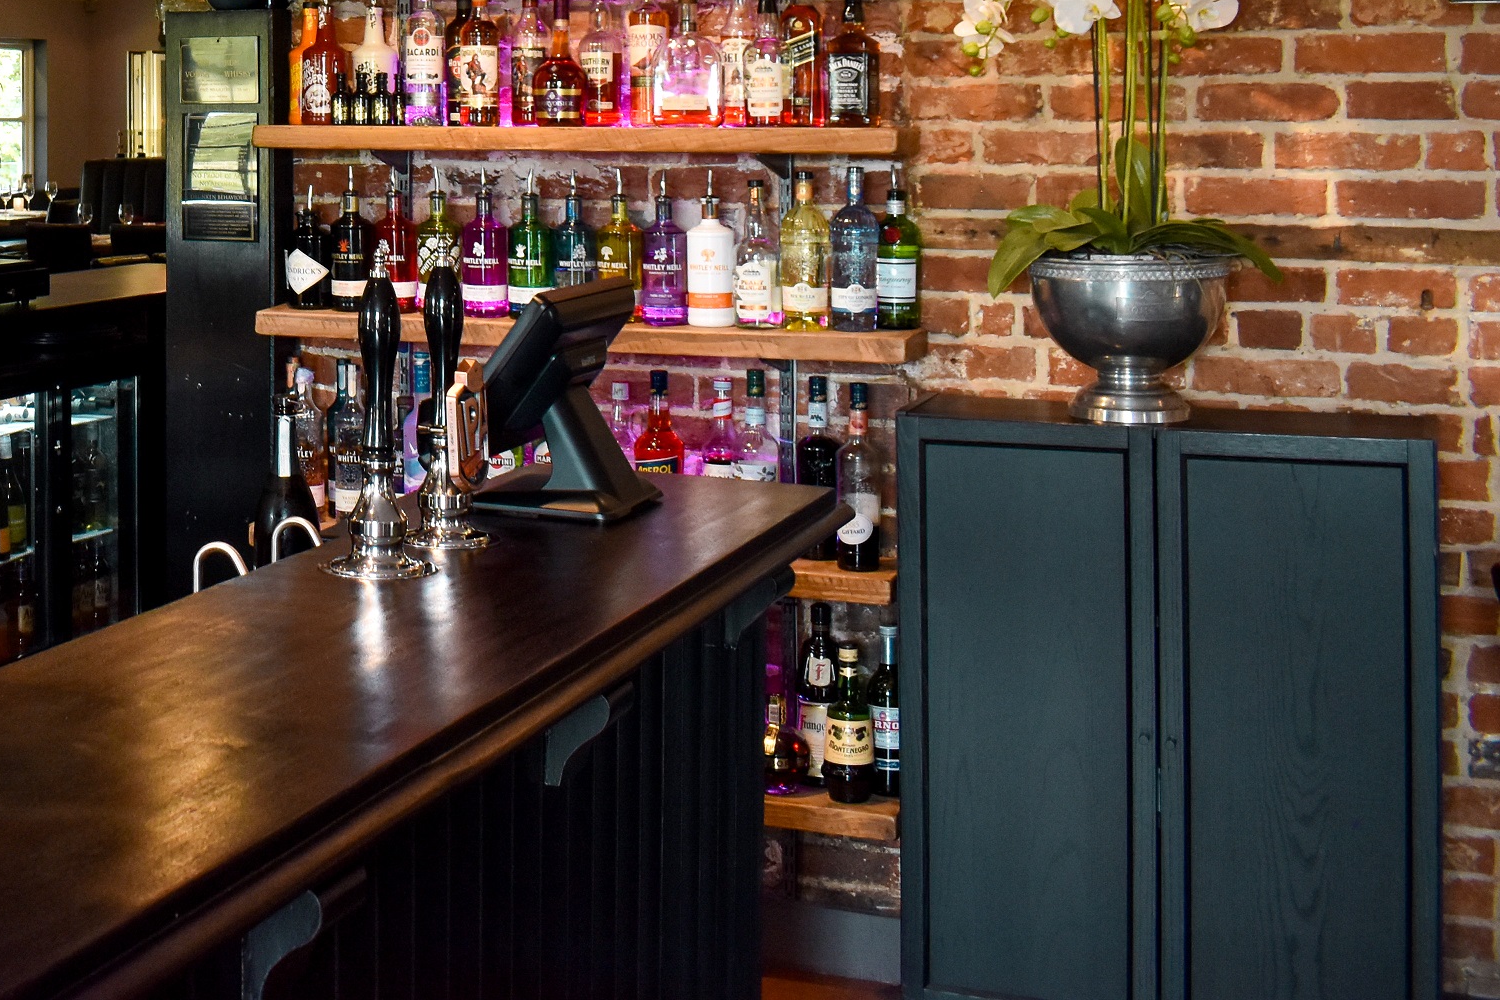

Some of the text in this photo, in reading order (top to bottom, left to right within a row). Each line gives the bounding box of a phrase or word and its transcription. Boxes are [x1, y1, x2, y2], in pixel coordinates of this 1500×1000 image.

[297, 450, 313, 458] TLEY
[488, 457, 513, 467] ARTINI
[874, 720, 899, 729] RNO
